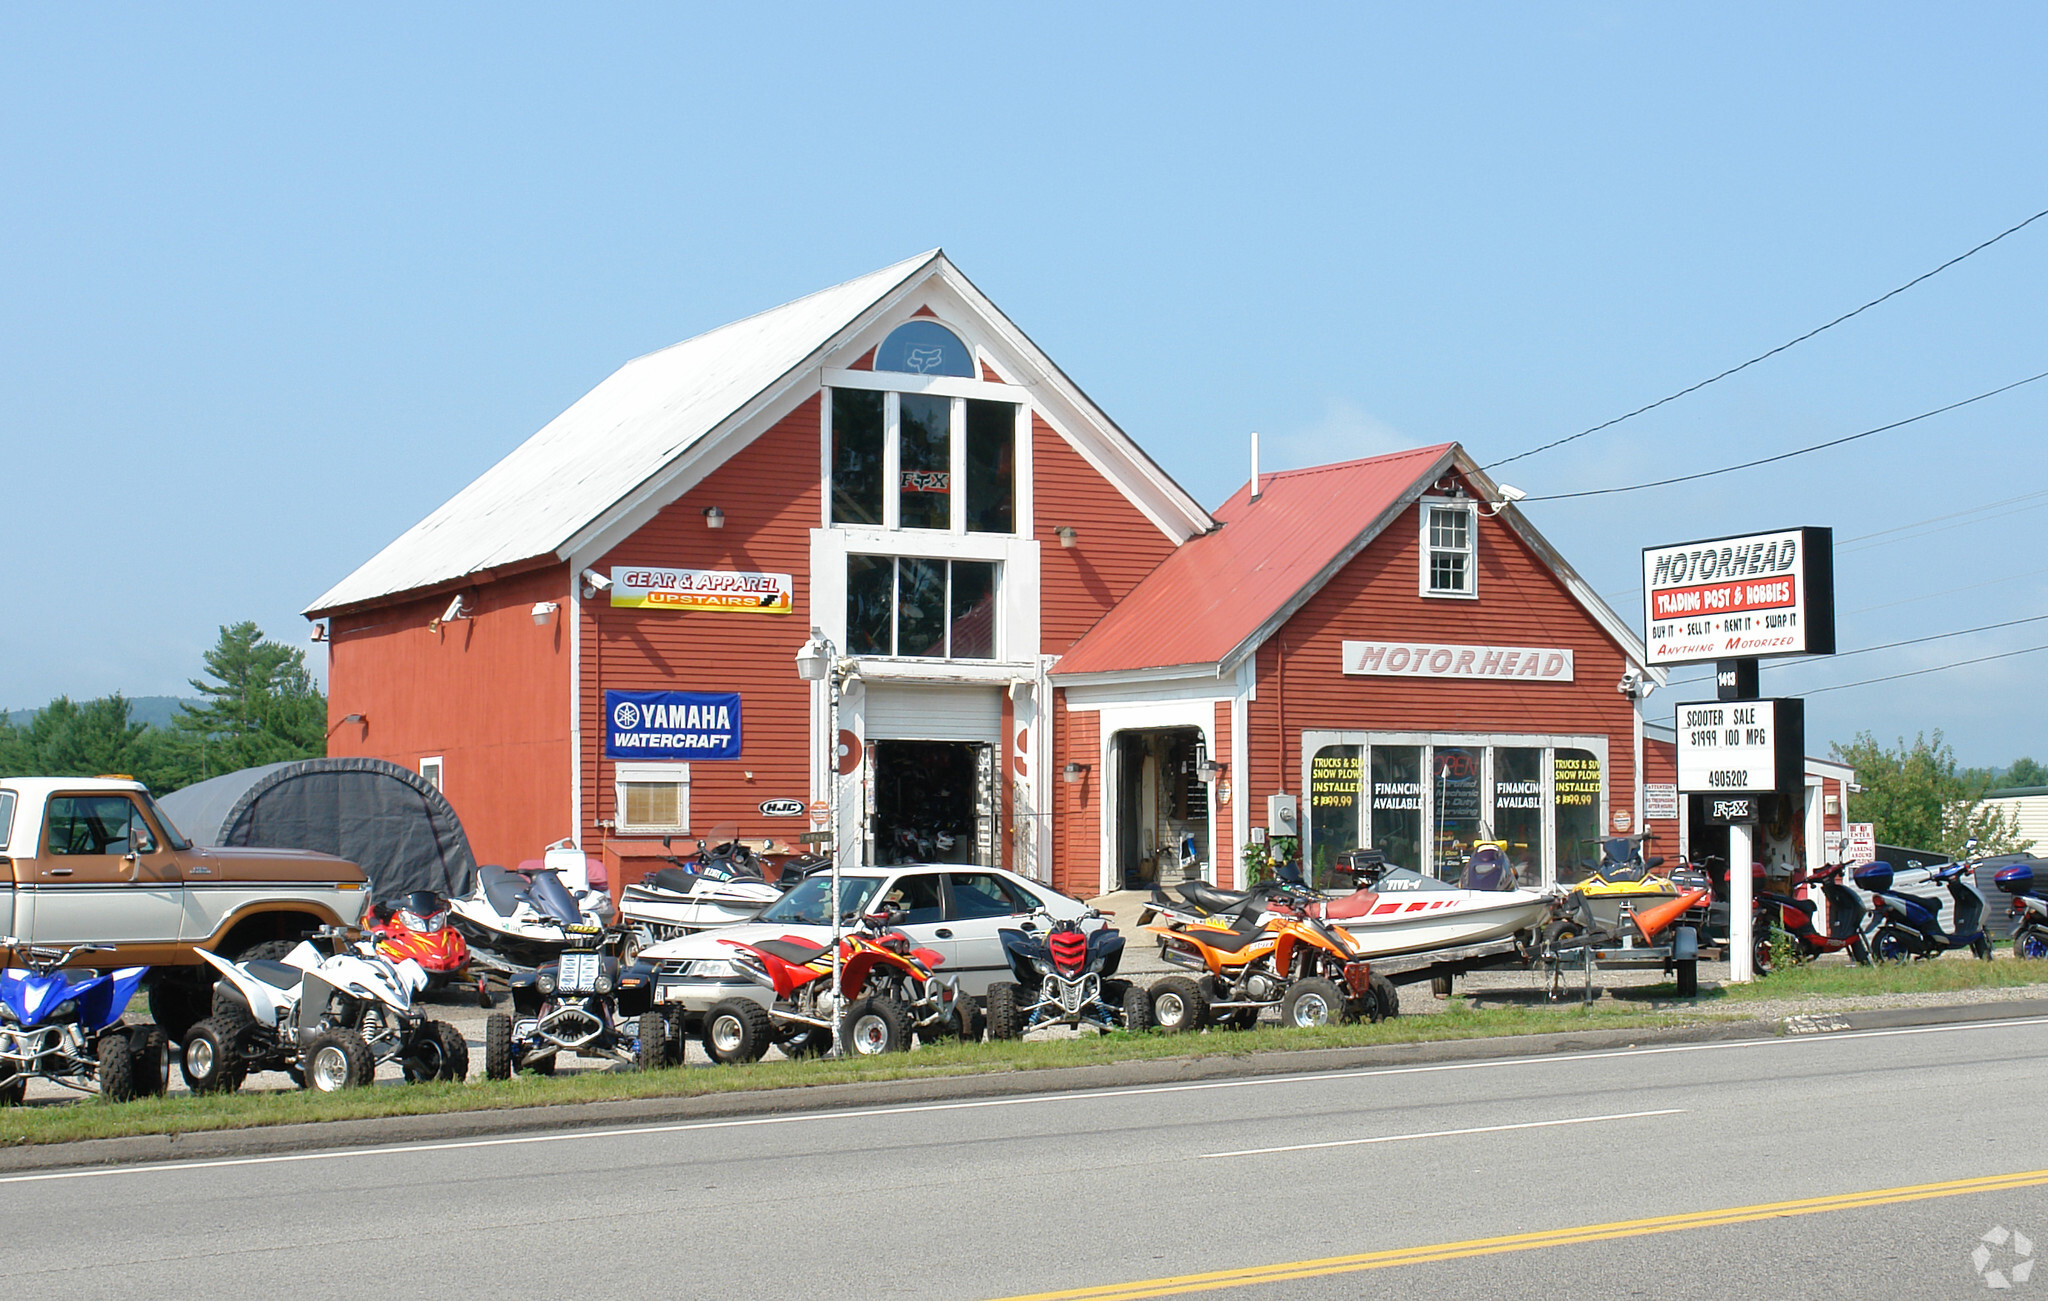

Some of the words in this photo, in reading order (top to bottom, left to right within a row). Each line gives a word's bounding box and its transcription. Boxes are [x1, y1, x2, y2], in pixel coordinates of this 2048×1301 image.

[1652, 539, 1796, 585] MOTORHEAD
[623, 572, 676, 589] GEAR
[679, 574, 693, 590] &
[697, 575, 780, 593] APPAREL
[650, 593, 757, 606] UPSTAIRS
[1657, 591, 1700, 614] TRADING
[1704, 588, 1731, 609] POST
[1734, 586, 1743, 605] &
[1746, 582, 1790, 605] HOBBIES
[1652, 625, 1666, 639] BUY
[1668, 625, 1674, 638] IT
[1687, 622, 1703, 636] SELL
[1704, 621, 1711, 634] IT
[1724, 618, 1742, 632] RENT
[1744, 617, 1751, 631] IT
[1765, 614, 1787, 629] SWAP
[1790, 613, 1797, 626] IT
[1657, 643, 1715, 656] ANYTHING
[1725, 637, 1794, 651] MOTORIZED
[1357, 646, 1564, 677] MOTORHEAD
[1717, 671, 1736, 687] 1413
[641, 704, 731, 730] YAMAHA
[1687, 709, 1723, 727] SCOOTER
[1733, 708, 1755, 725] SALE
[614, 733, 732, 749] WATERCRAFT
[1725, 729, 1740, 746] 100
[1746, 728, 1765, 745] MPG
[1314, 758, 1341, 768] TRUCKS
[1343, 758, 1349, 768] &
[1434, 755, 1479, 776] OPEN
[1555, 759, 1579, 769] TRUCKS
[1581, 760, 1587, 769] &
[1313, 769, 1336, 779] SNOW
[1338, 769, 1364, 779] PLOWS
[1555, 770, 1576, 780] SNOW
[1578, 770, 1601, 780] PLOWS
[1708, 770, 1748, 787] 4905202
[1313, 782, 1364, 793] INSTALLED
[1556, 782, 1601, 792] INSTALLED
[766, 803, 797, 812] HJC
[1313, 796, 1319, 806] $
[1373, 798, 1425, 810] AVAILABLE
